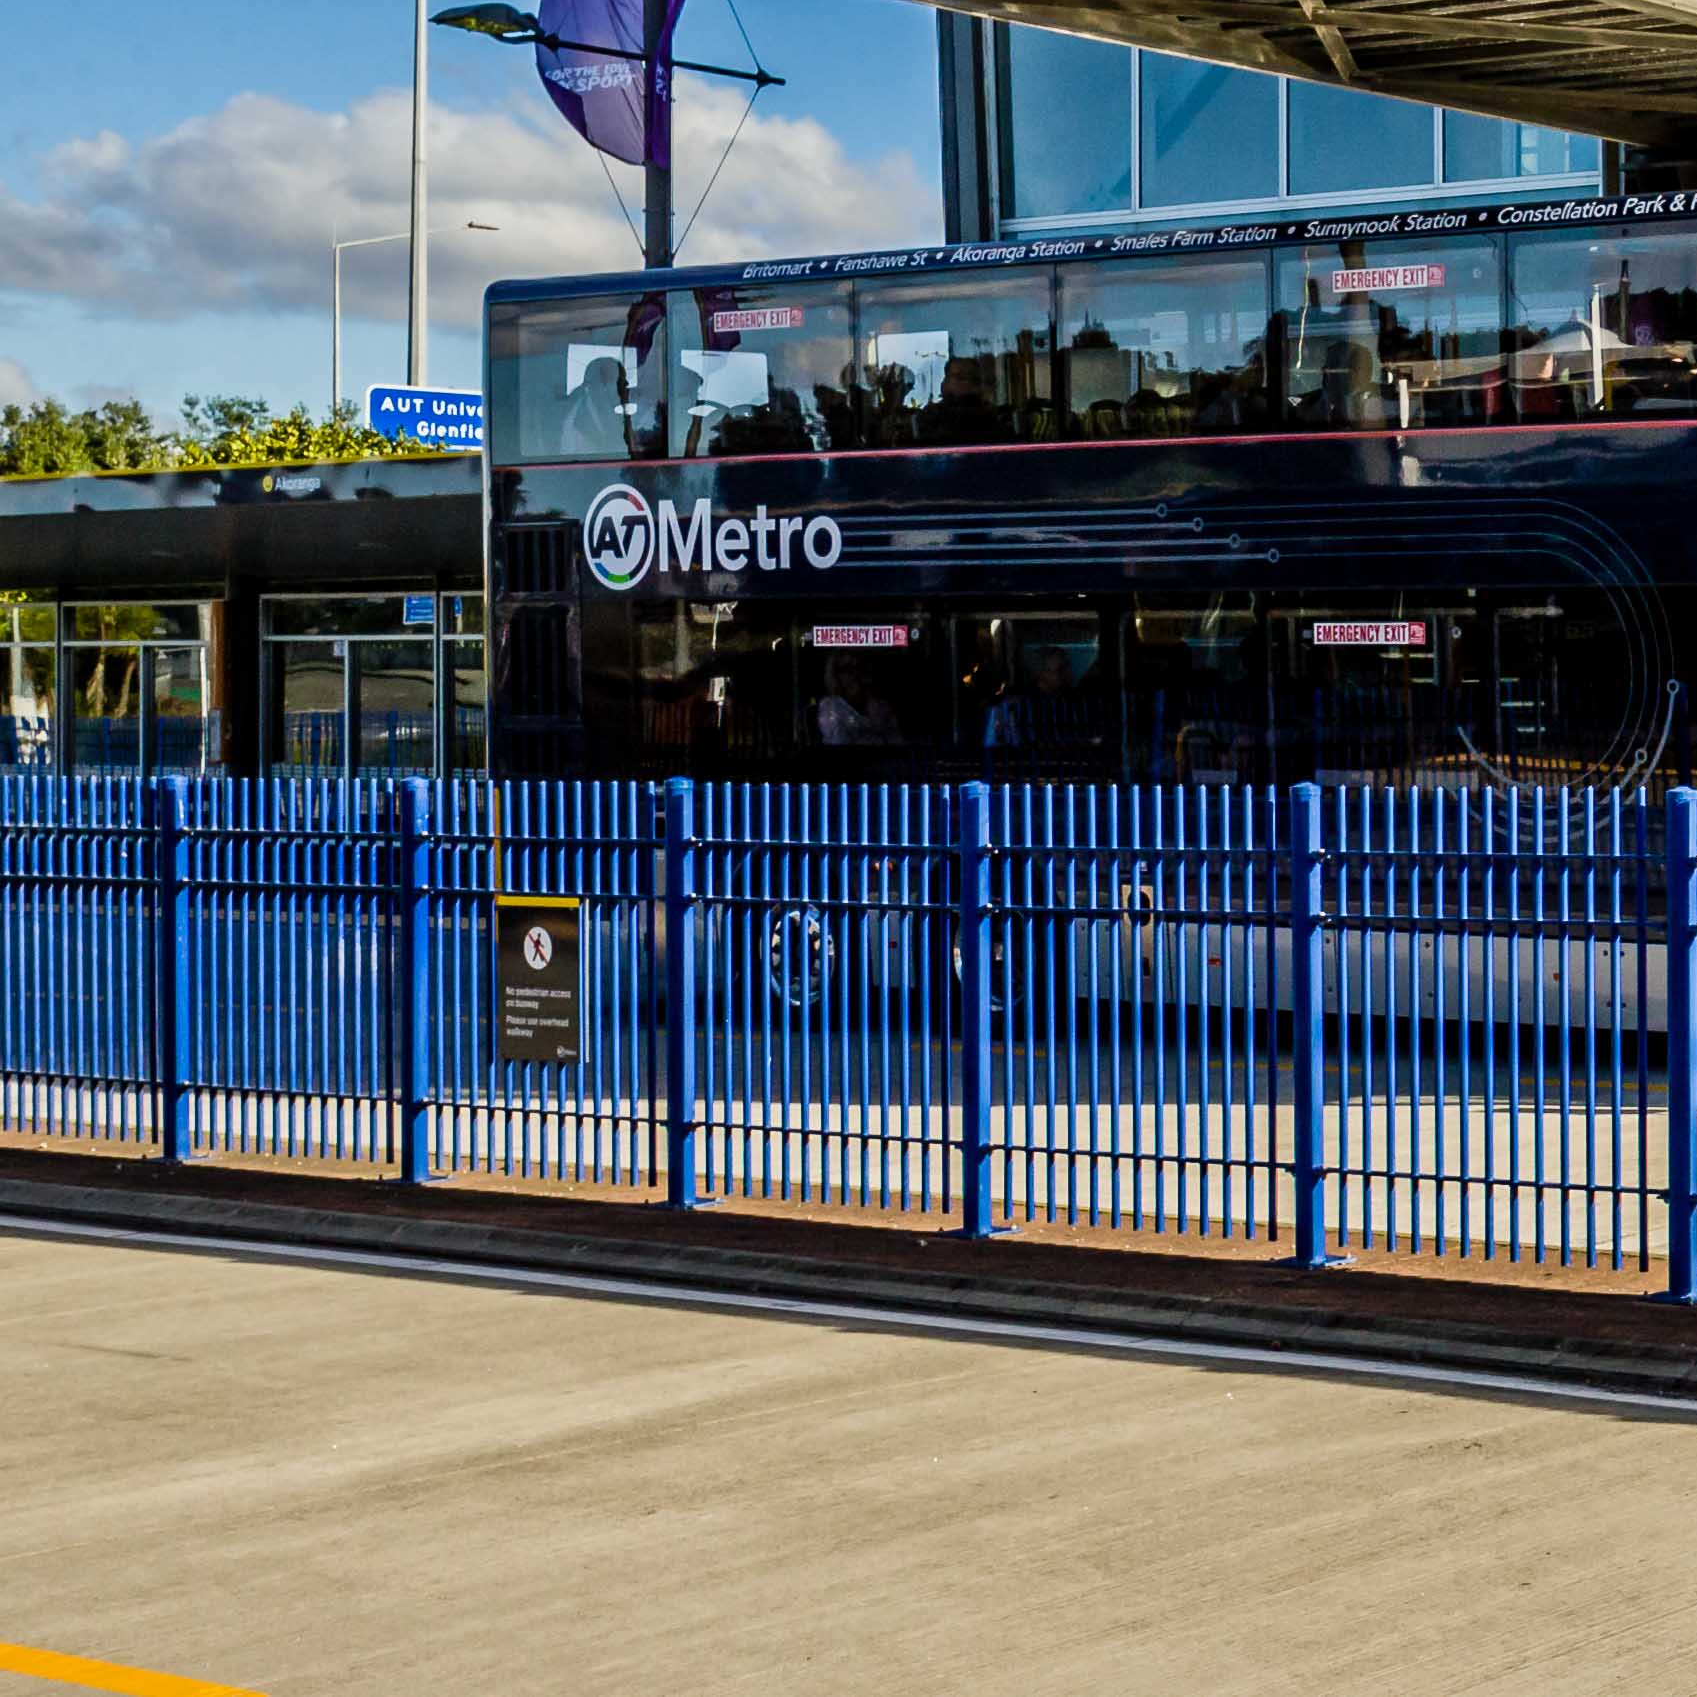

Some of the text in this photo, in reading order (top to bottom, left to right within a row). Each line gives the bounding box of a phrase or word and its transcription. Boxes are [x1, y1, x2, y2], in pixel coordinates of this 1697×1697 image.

[742, 261, 812, 279] Britomart
[834, 255, 907, 272] Fanshawe
[910, 251, 928, 266] St
[950, 244, 1025, 263] Akoranga
[1028, 239, 1085, 258] Station
[1111, 233, 1167, 252] Smales
[1171, 230, 1214, 247] Farm
[1220, 225, 1277, 244] Station
[1304, 215, 1400, 240] Sunnynook
[1404, 212, 1467, 231] Station
[1497, 200, 1618, 225] Constellation
[1622, 196, 1663, 216] Park
[1669, 197, 1685, 213] &
[1334, 267, 1425, 290] EMERGENCY EXIT
[716, 310, 788, 329] EMERGENCY EXIT
[381, 396, 424, 413] AUT
[275, 476, 320, 492] Akoranga
[658, 498, 842, 572] Metro
[816, 628, 891, 644] EMERGENCY EXIT
[1316, 624, 1407, 642] EMERGENCY EXIT
